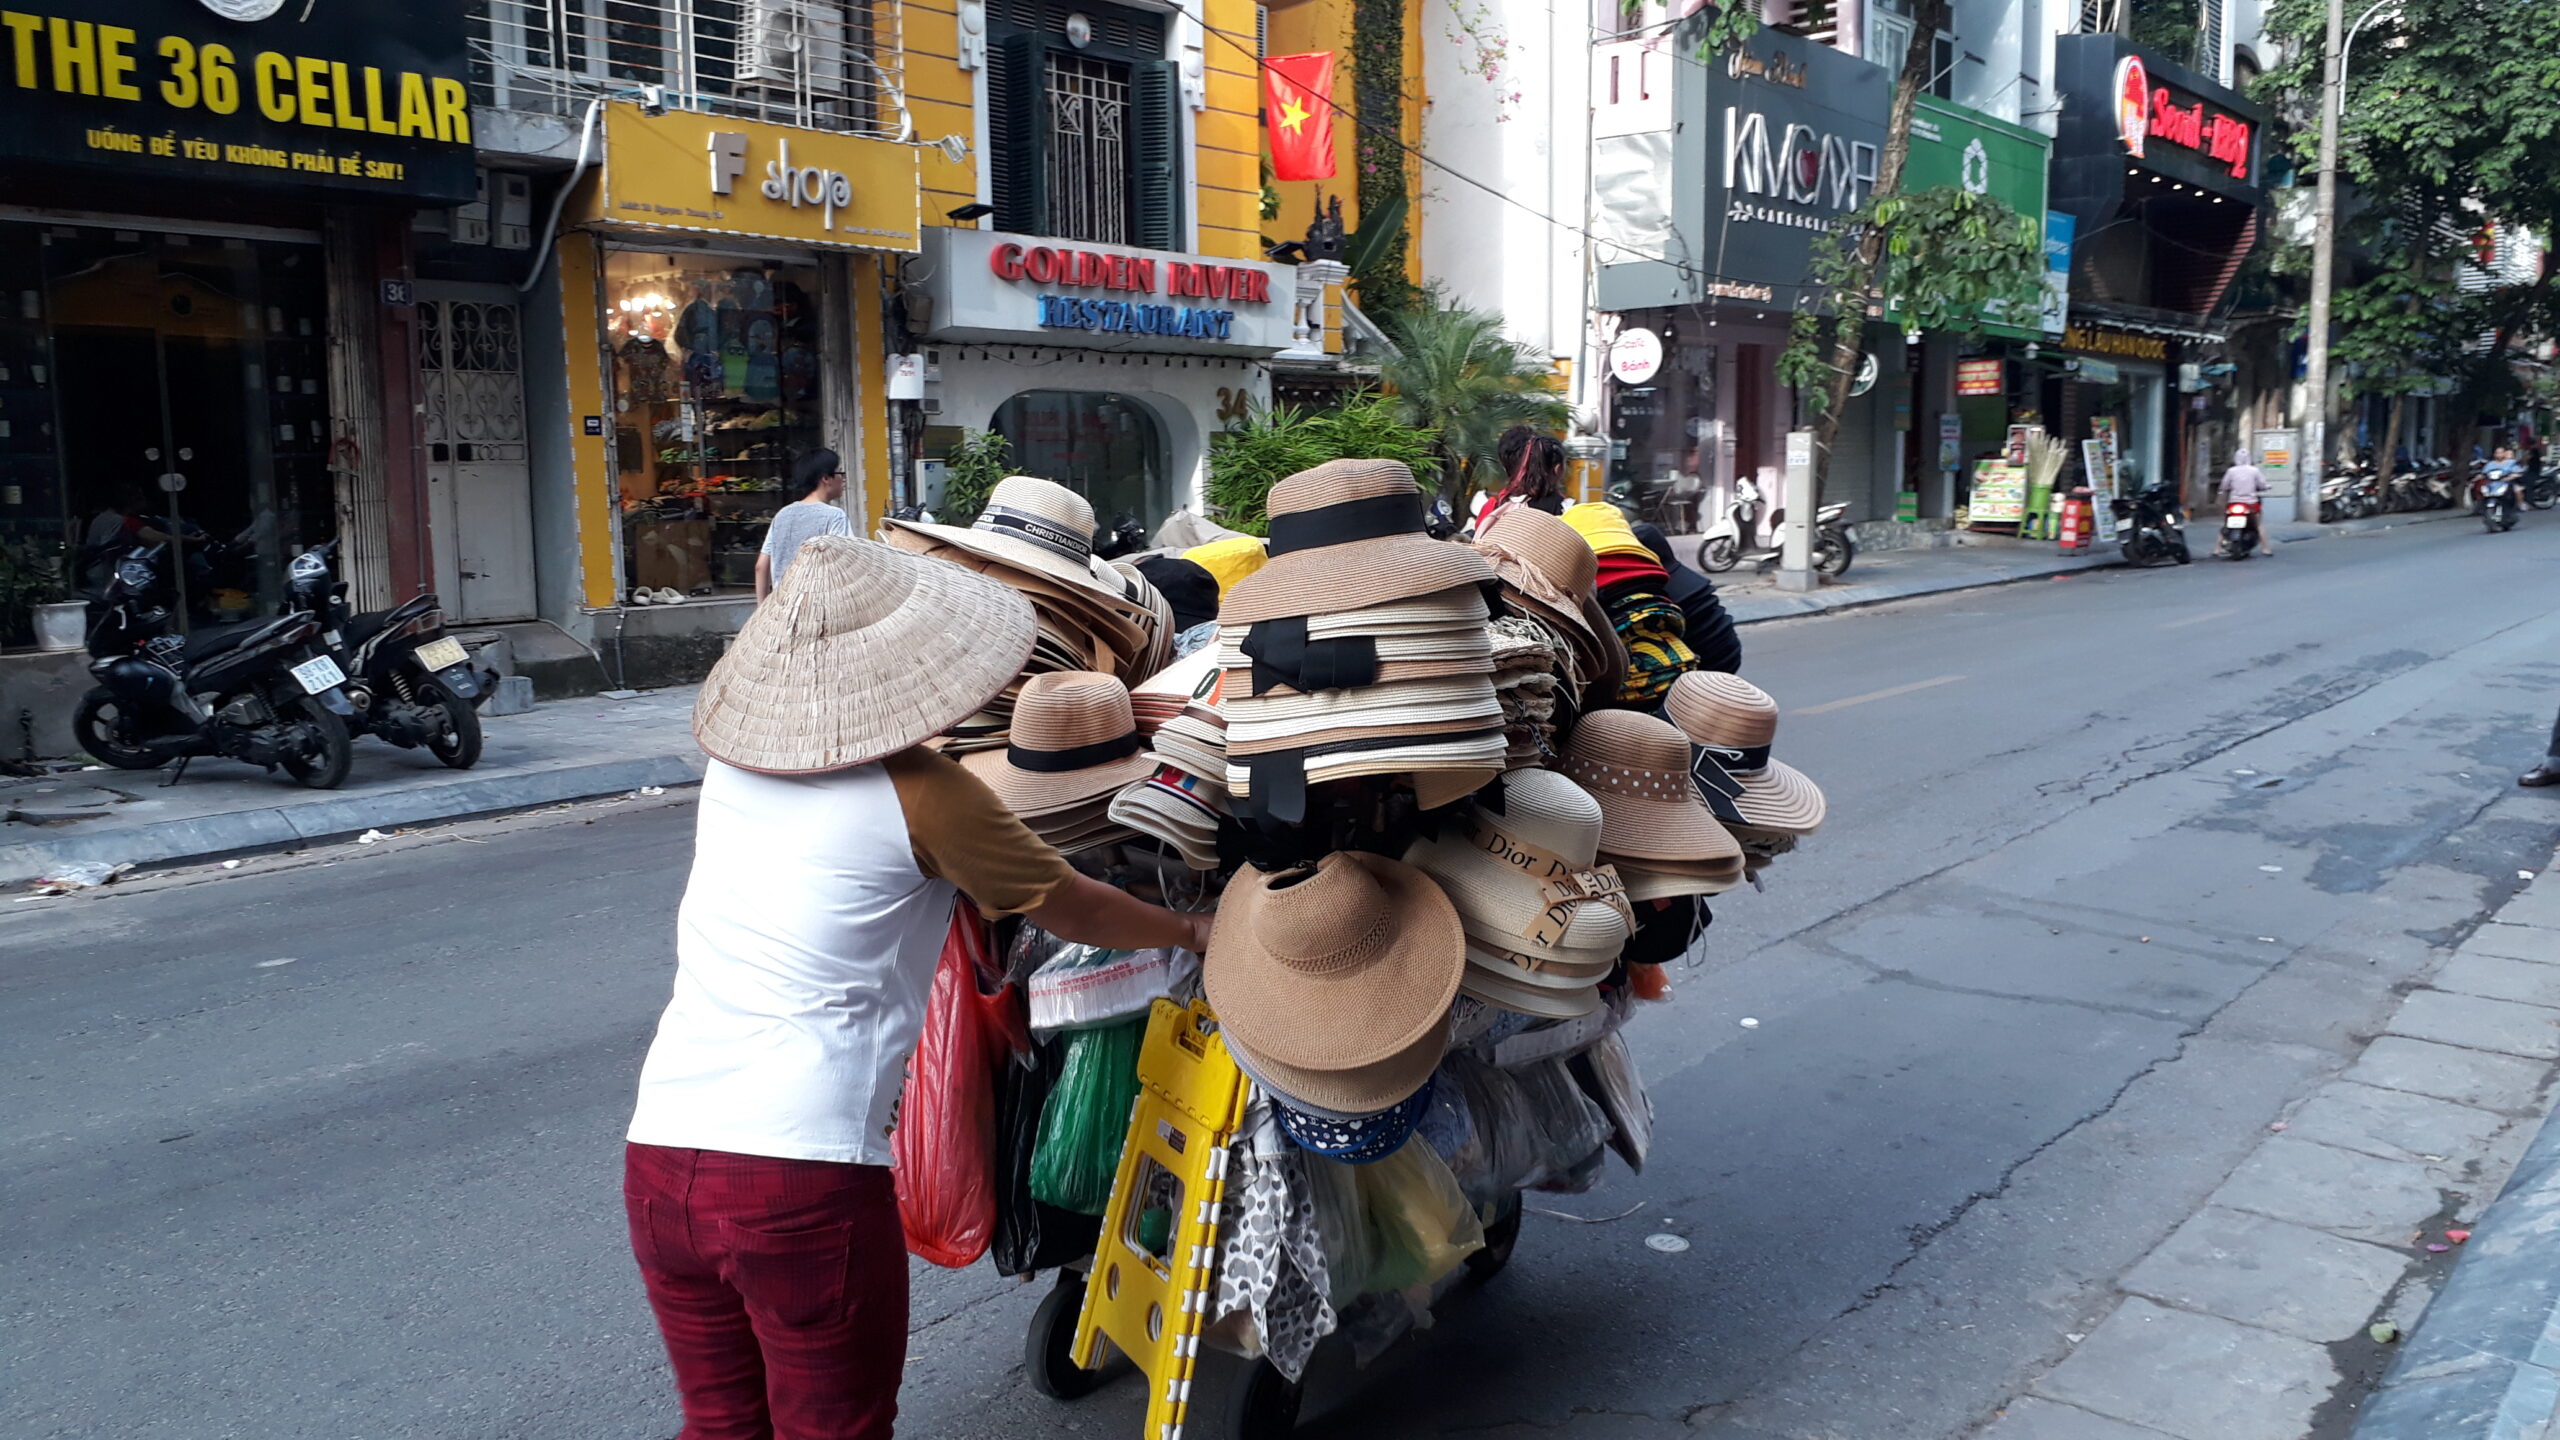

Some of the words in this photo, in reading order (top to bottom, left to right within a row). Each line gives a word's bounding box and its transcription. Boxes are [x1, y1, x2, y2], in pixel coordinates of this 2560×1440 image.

[2, 10, 141, 101] THE
[159, 35, 240, 116] 36
[254, 50, 471, 144] CELLAR
[86, 126, 143, 153] UỐNG
[182, 137, 219, 161] YÊU
[226, 144, 287, 168] KHÔNG
[292, 149, 334, 173] PHẢI
[365, 160, 404, 180] SAY!
[761, 138, 851, 230] shop
[990, 242, 1156, 293] GOLDEN
[1168, 261, 1270, 303] RIVER
[1038, 293, 1234, 339] RESTAURANT
[1216, 387, 1249, 421] 34
[1486, 832, 1537, 869] Dior
